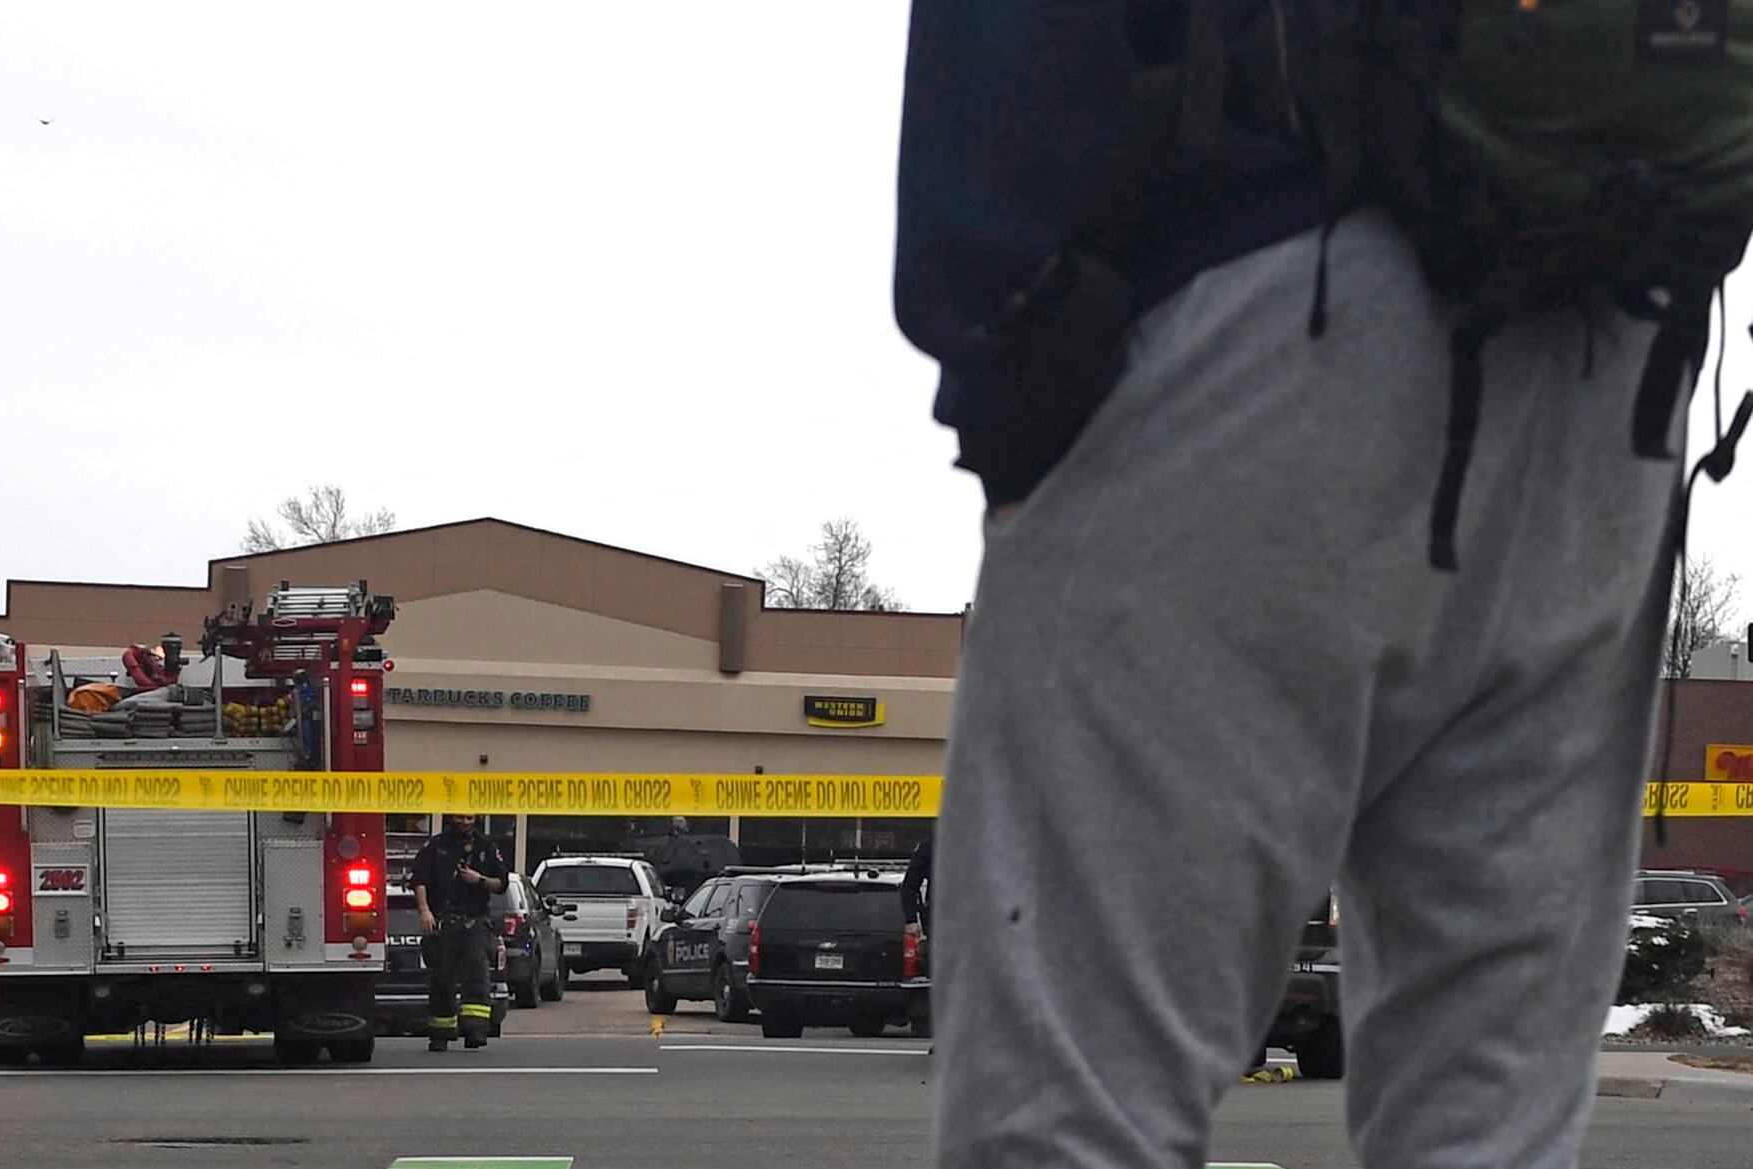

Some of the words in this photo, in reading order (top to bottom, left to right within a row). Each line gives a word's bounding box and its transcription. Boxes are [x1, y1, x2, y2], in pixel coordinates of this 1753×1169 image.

[385, 688, 504, 707] TARBUCKS
[510, 692, 591, 711] COFFEE
[675, 944, 710, 962] POLICE
